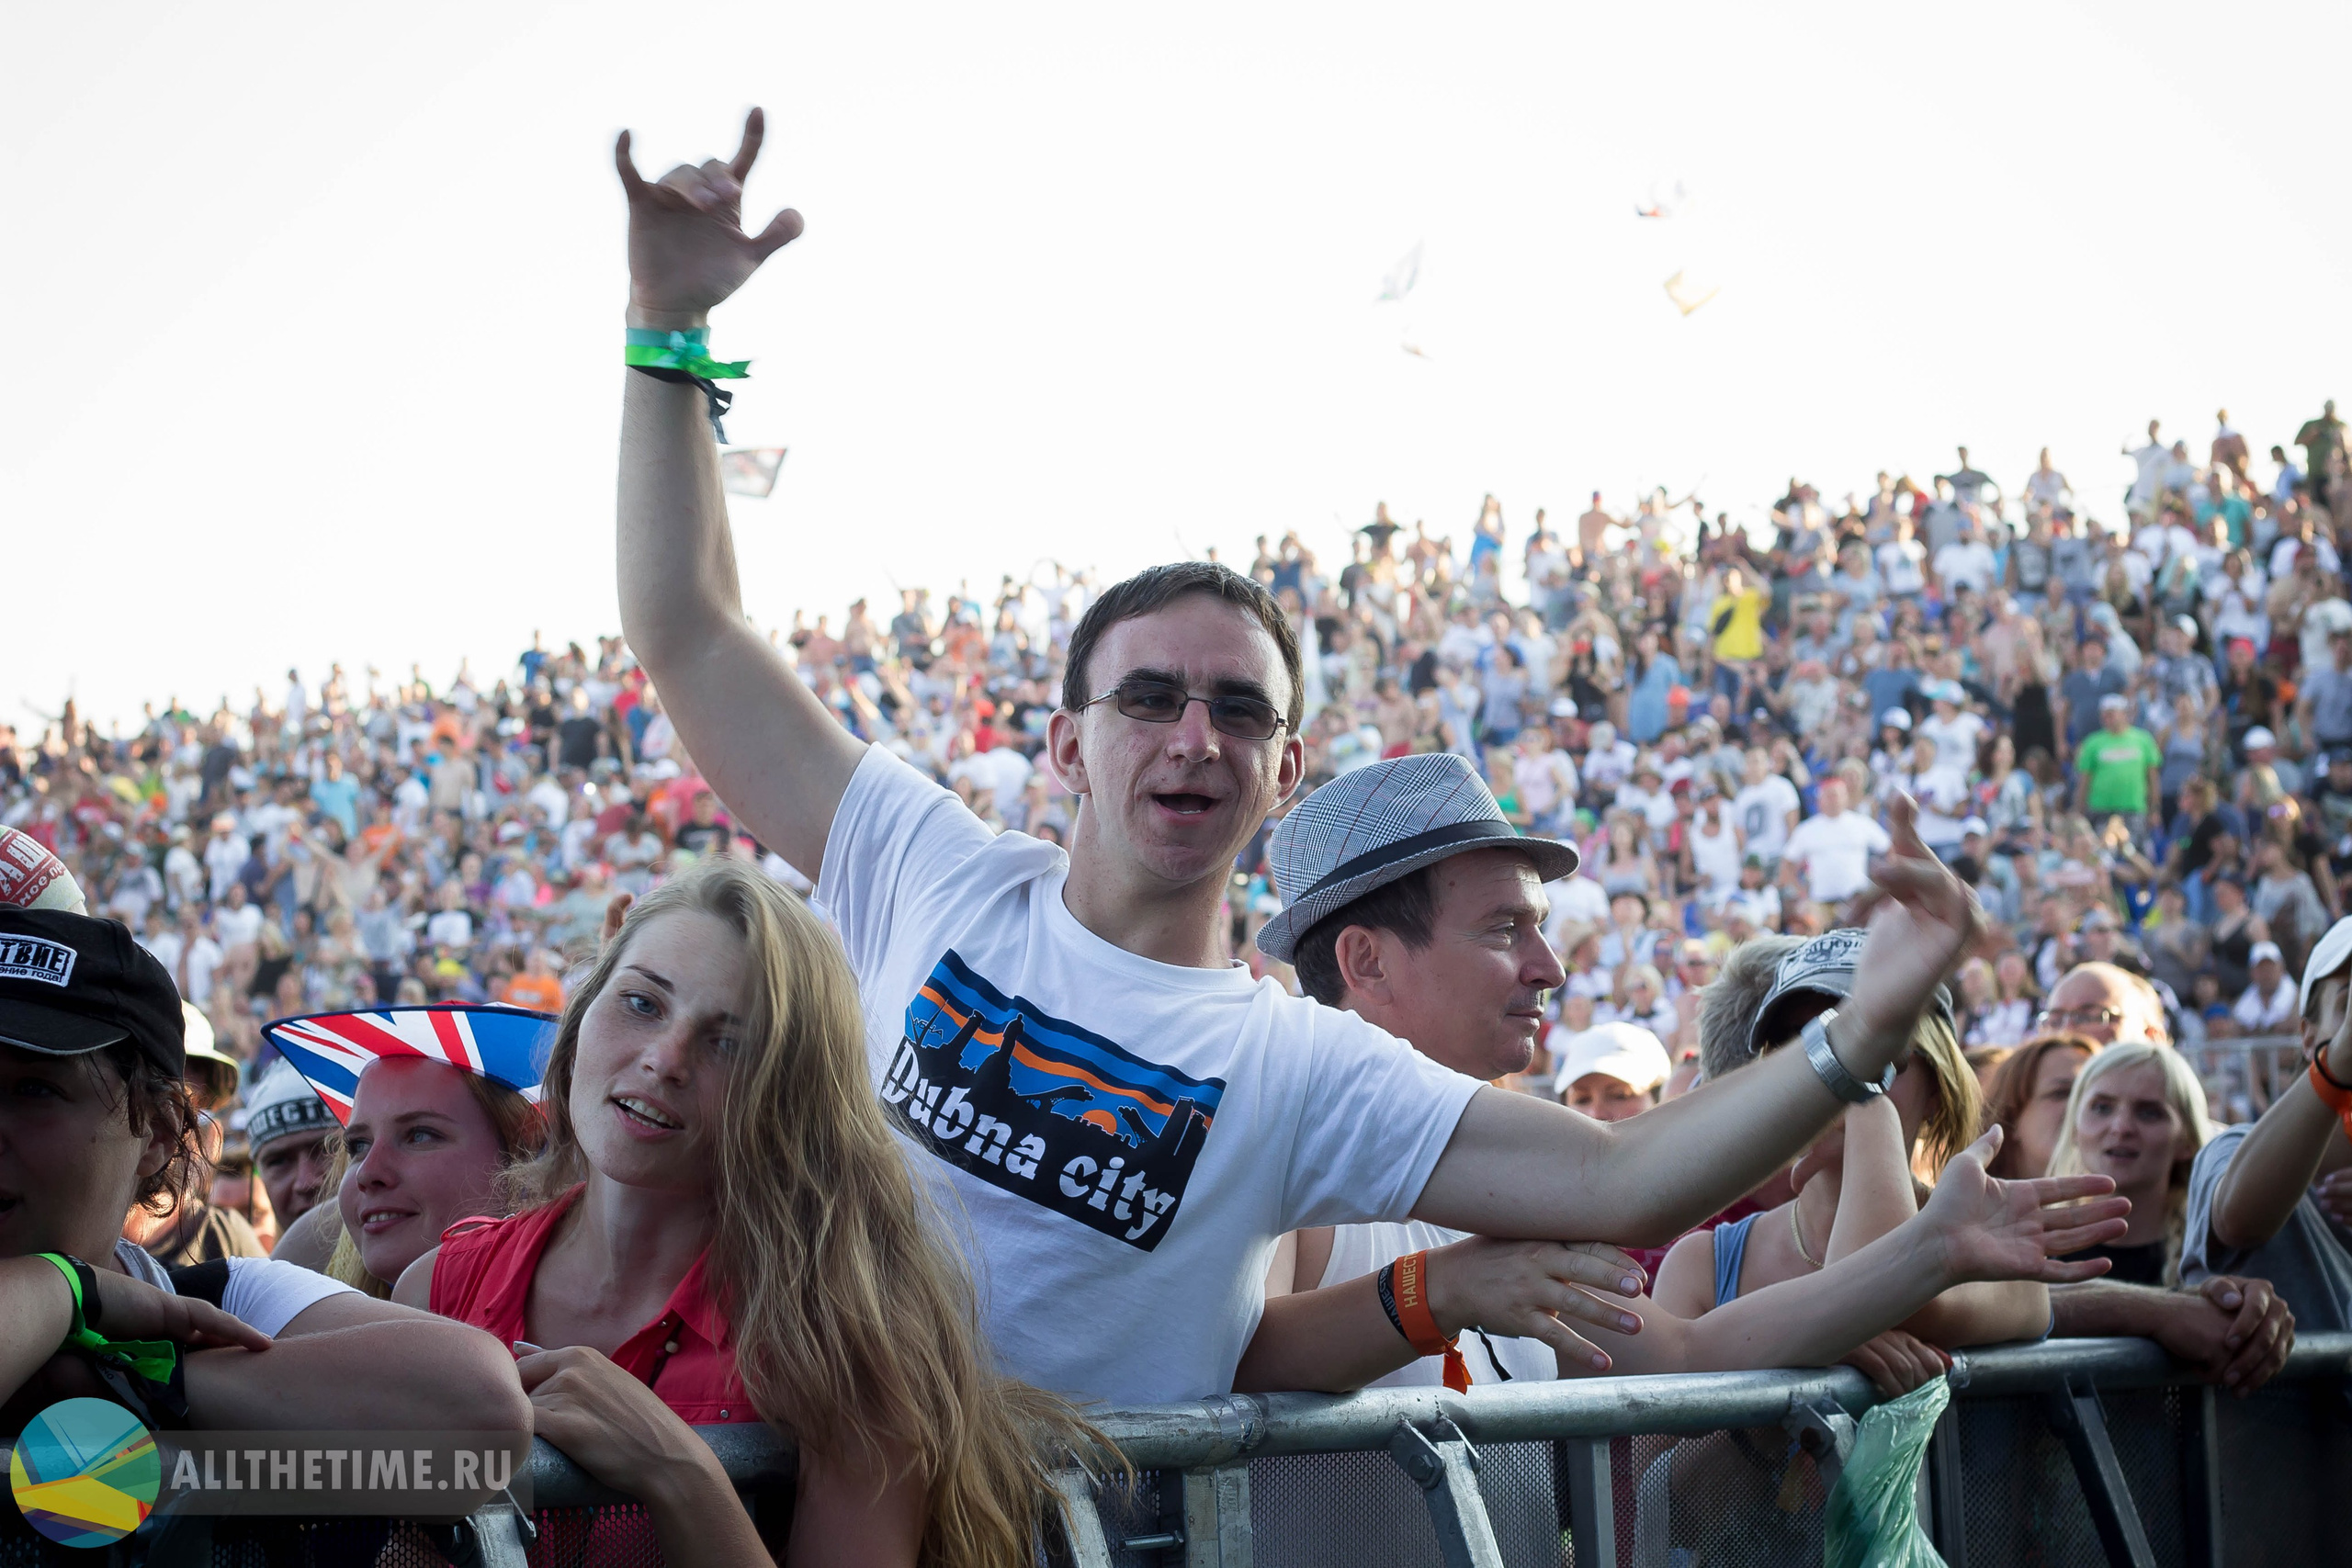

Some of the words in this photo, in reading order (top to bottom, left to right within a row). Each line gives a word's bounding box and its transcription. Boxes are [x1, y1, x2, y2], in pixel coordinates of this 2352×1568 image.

[881, 1042, 1046, 1180] Dubna
[1058, 1156, 1176, 1241] city
[1402, 1253, 1419, 1309] НАШЕСТ
